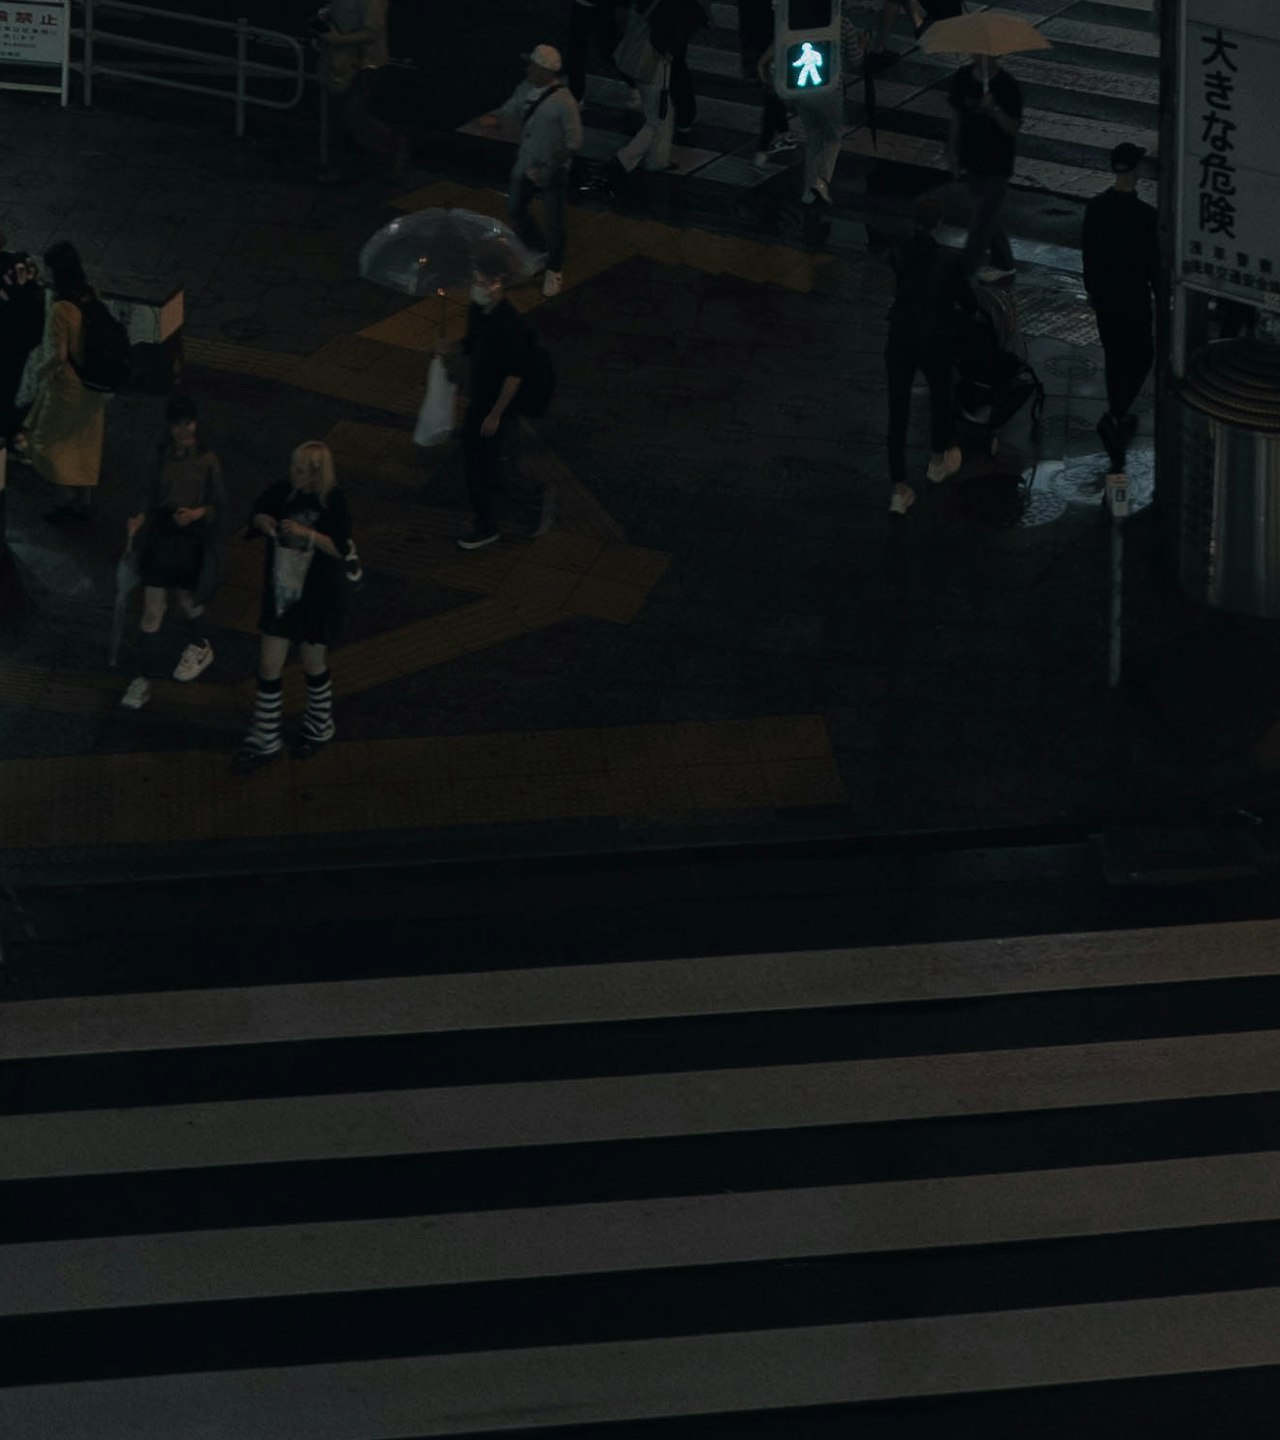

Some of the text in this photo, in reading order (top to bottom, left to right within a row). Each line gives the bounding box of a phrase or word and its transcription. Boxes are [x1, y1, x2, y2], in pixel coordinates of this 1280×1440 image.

[1198, 29, 1238, 239] 大きな危険
